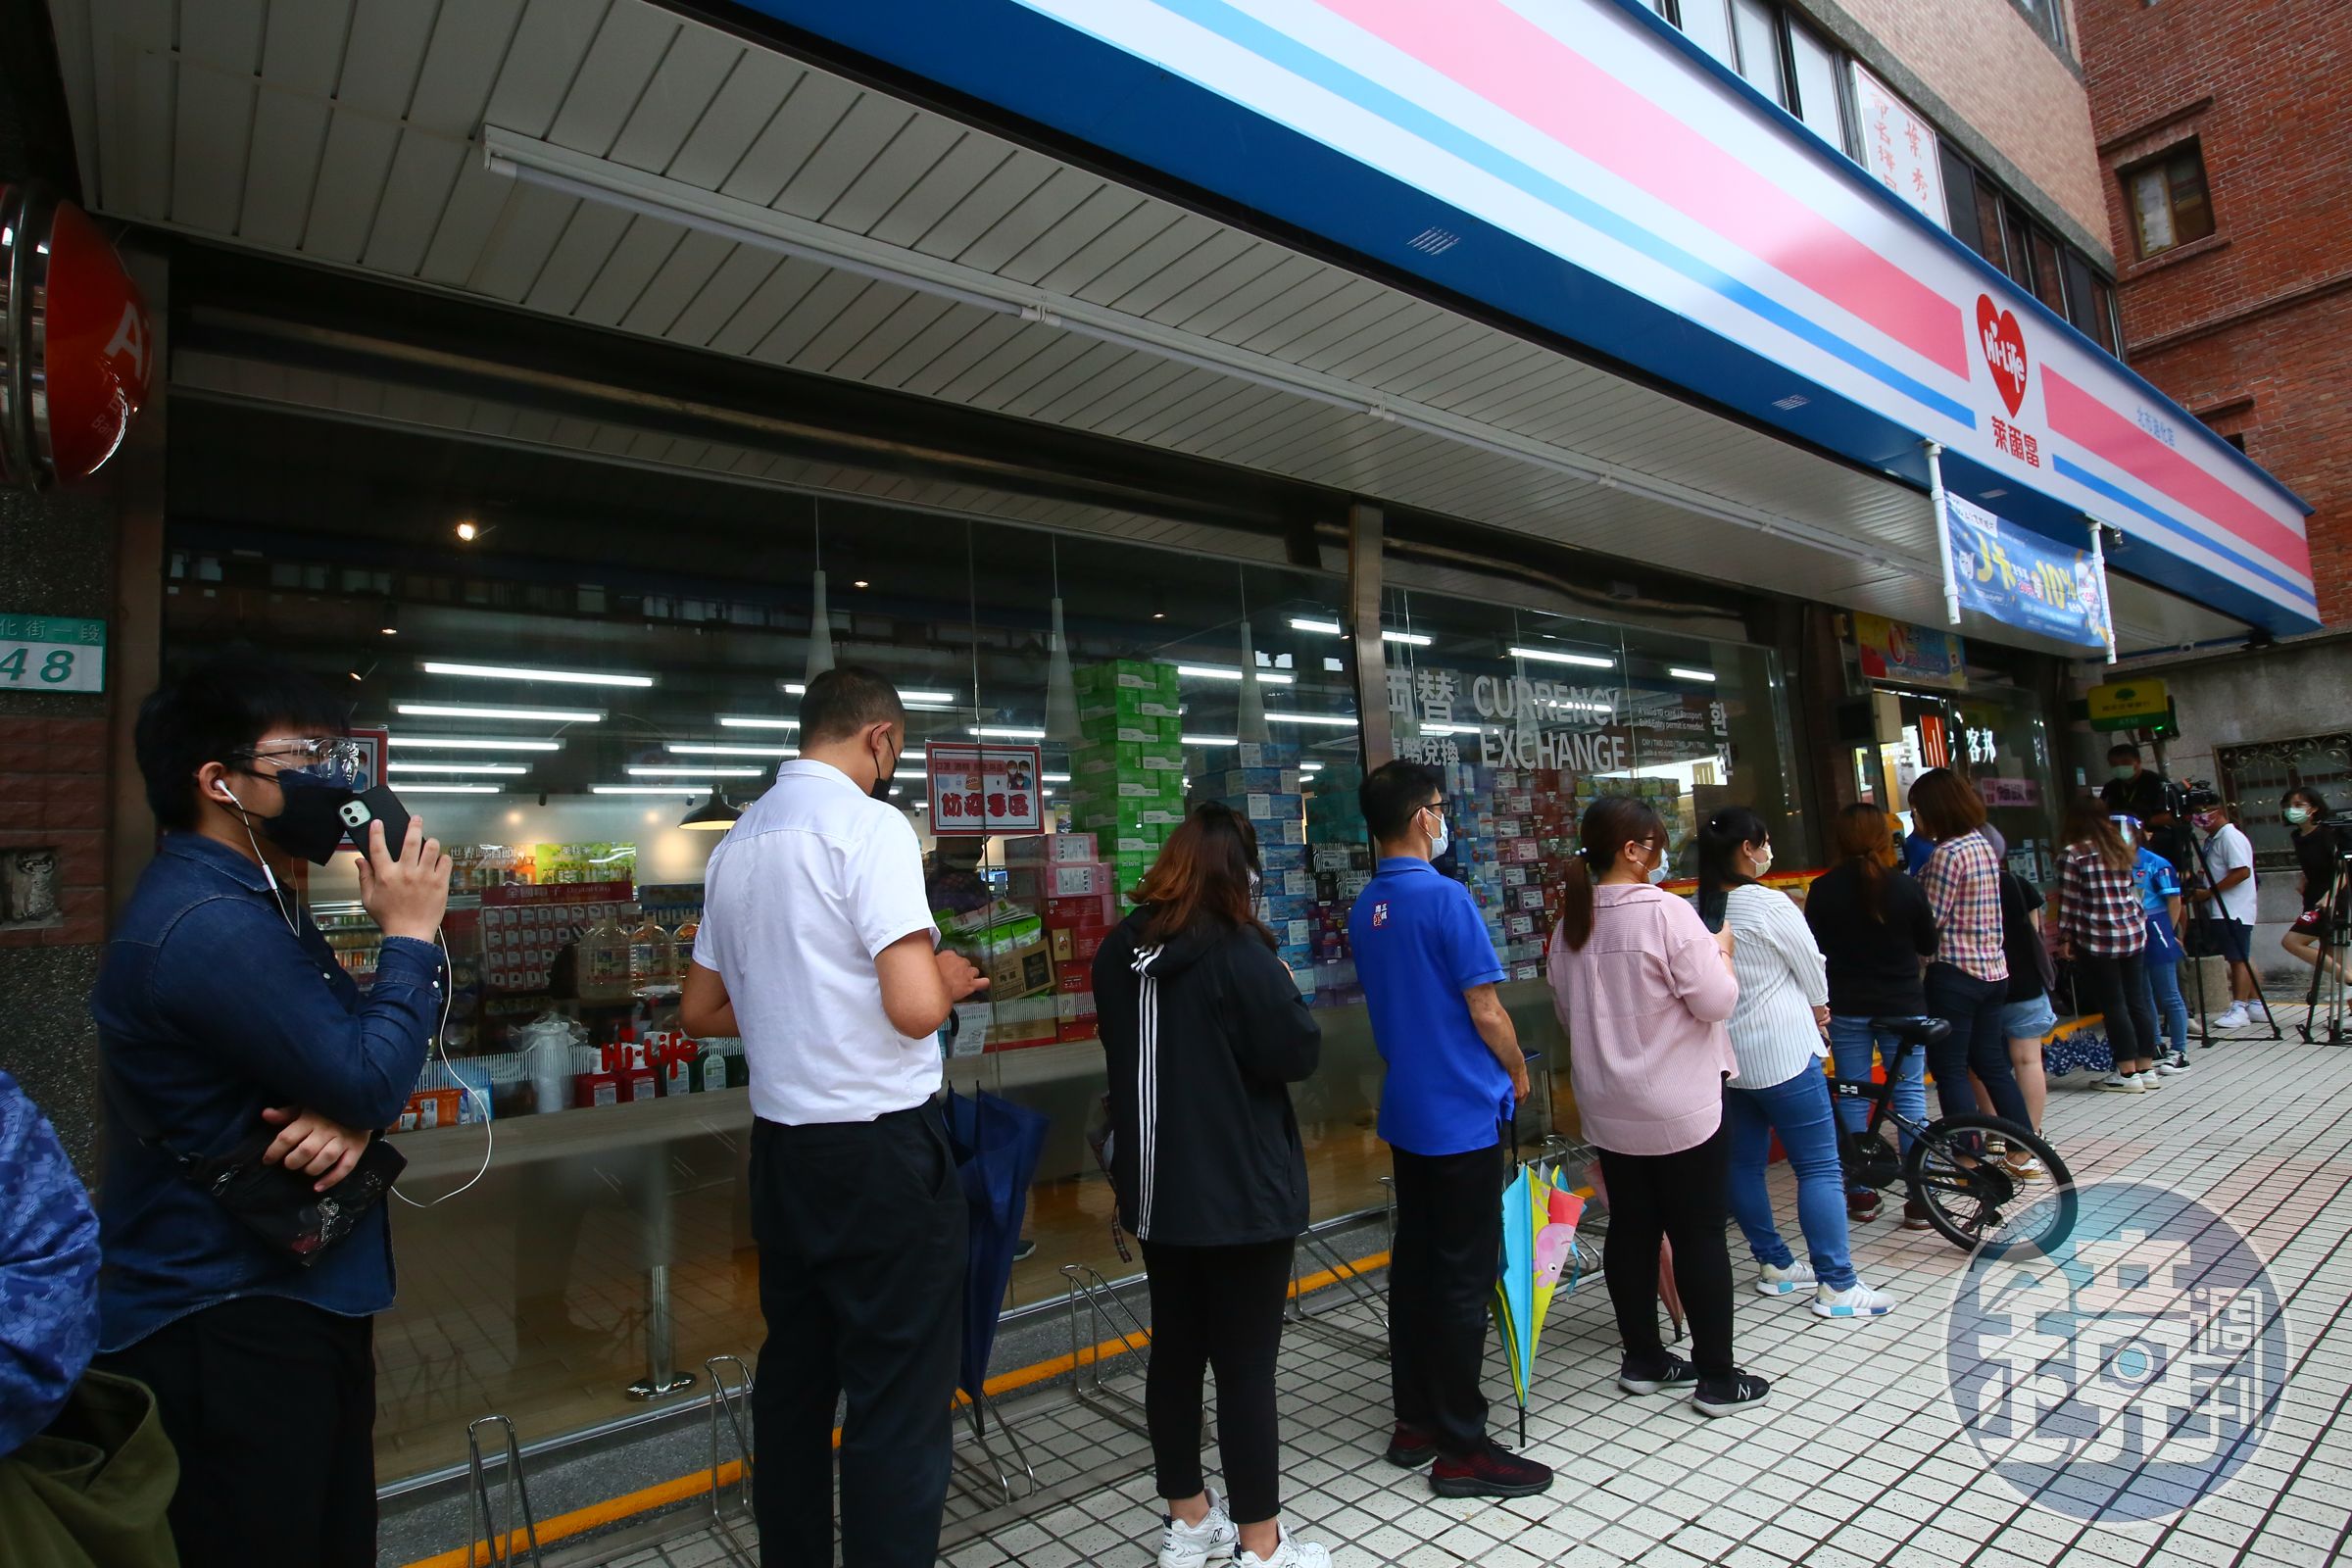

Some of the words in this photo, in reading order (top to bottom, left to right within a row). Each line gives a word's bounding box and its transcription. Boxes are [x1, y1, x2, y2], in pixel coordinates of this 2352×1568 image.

[1984, 321, 2026, 394] Hi-Life
[1990, 415, 2039, 468] 萊爾富
[0, 618, 100, 642] 化街一段
[0, 648, 74, 683] 48
[1472, 675, 1621, 727] CURRENCY
[1479, 725, 1628, 772] EXCHANGE
[601, 1028, 699, 1081] Hi-Life
